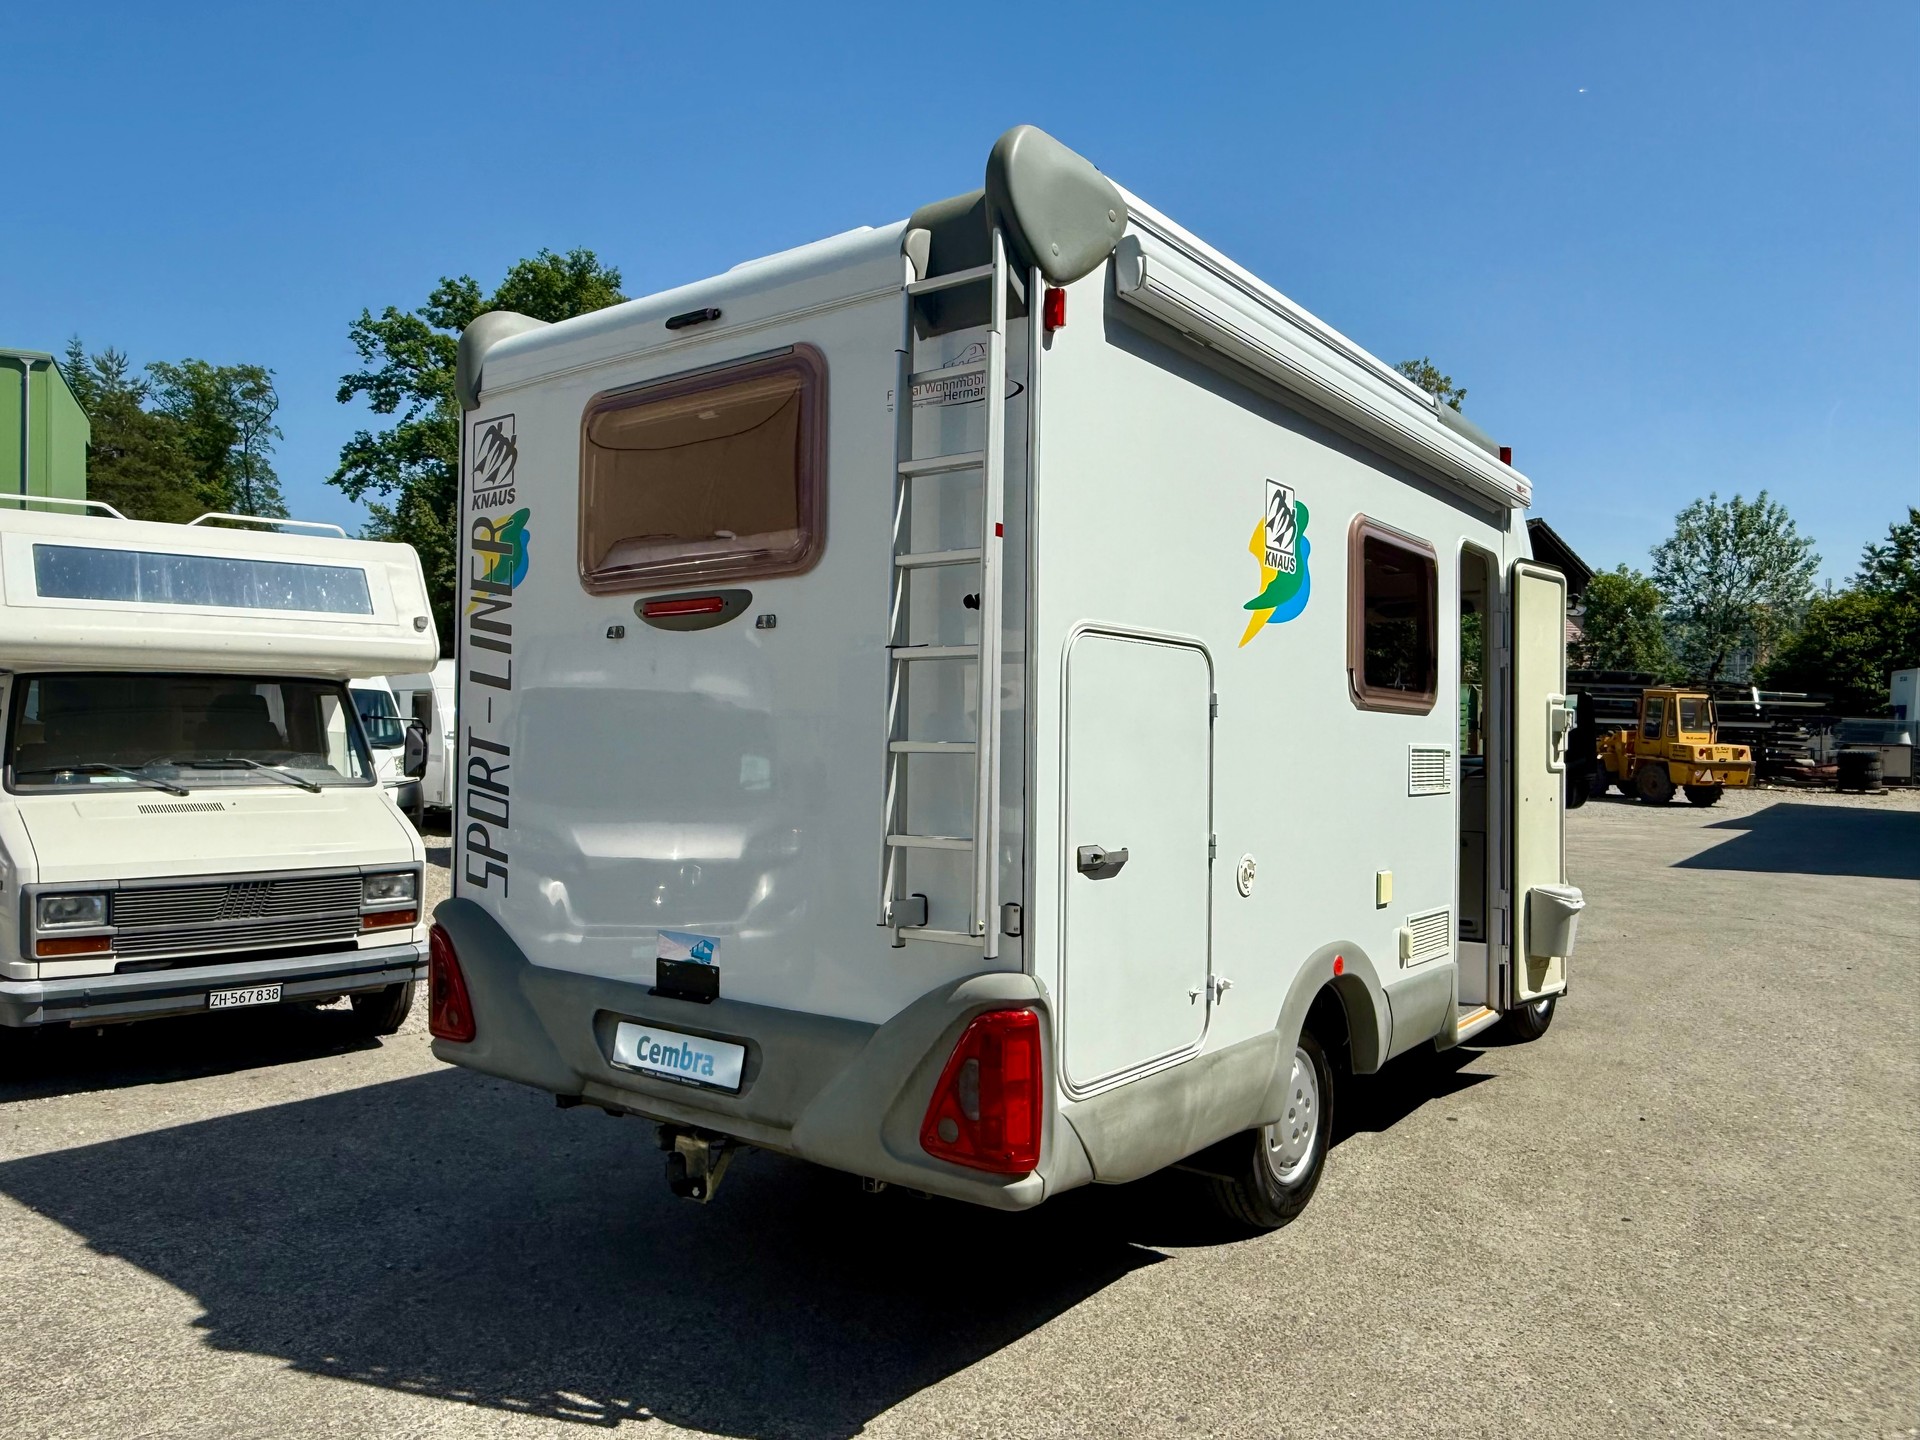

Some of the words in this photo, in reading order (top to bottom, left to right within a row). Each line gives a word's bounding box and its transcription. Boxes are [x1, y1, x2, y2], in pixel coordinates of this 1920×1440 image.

[925, 373, 985, 393] Wohnmobi
[472, 487, 516, 511] KNAUS
[1264, 551, 1296, 572] KNAUS
[636, 1035, 715, 1077] Cembra
